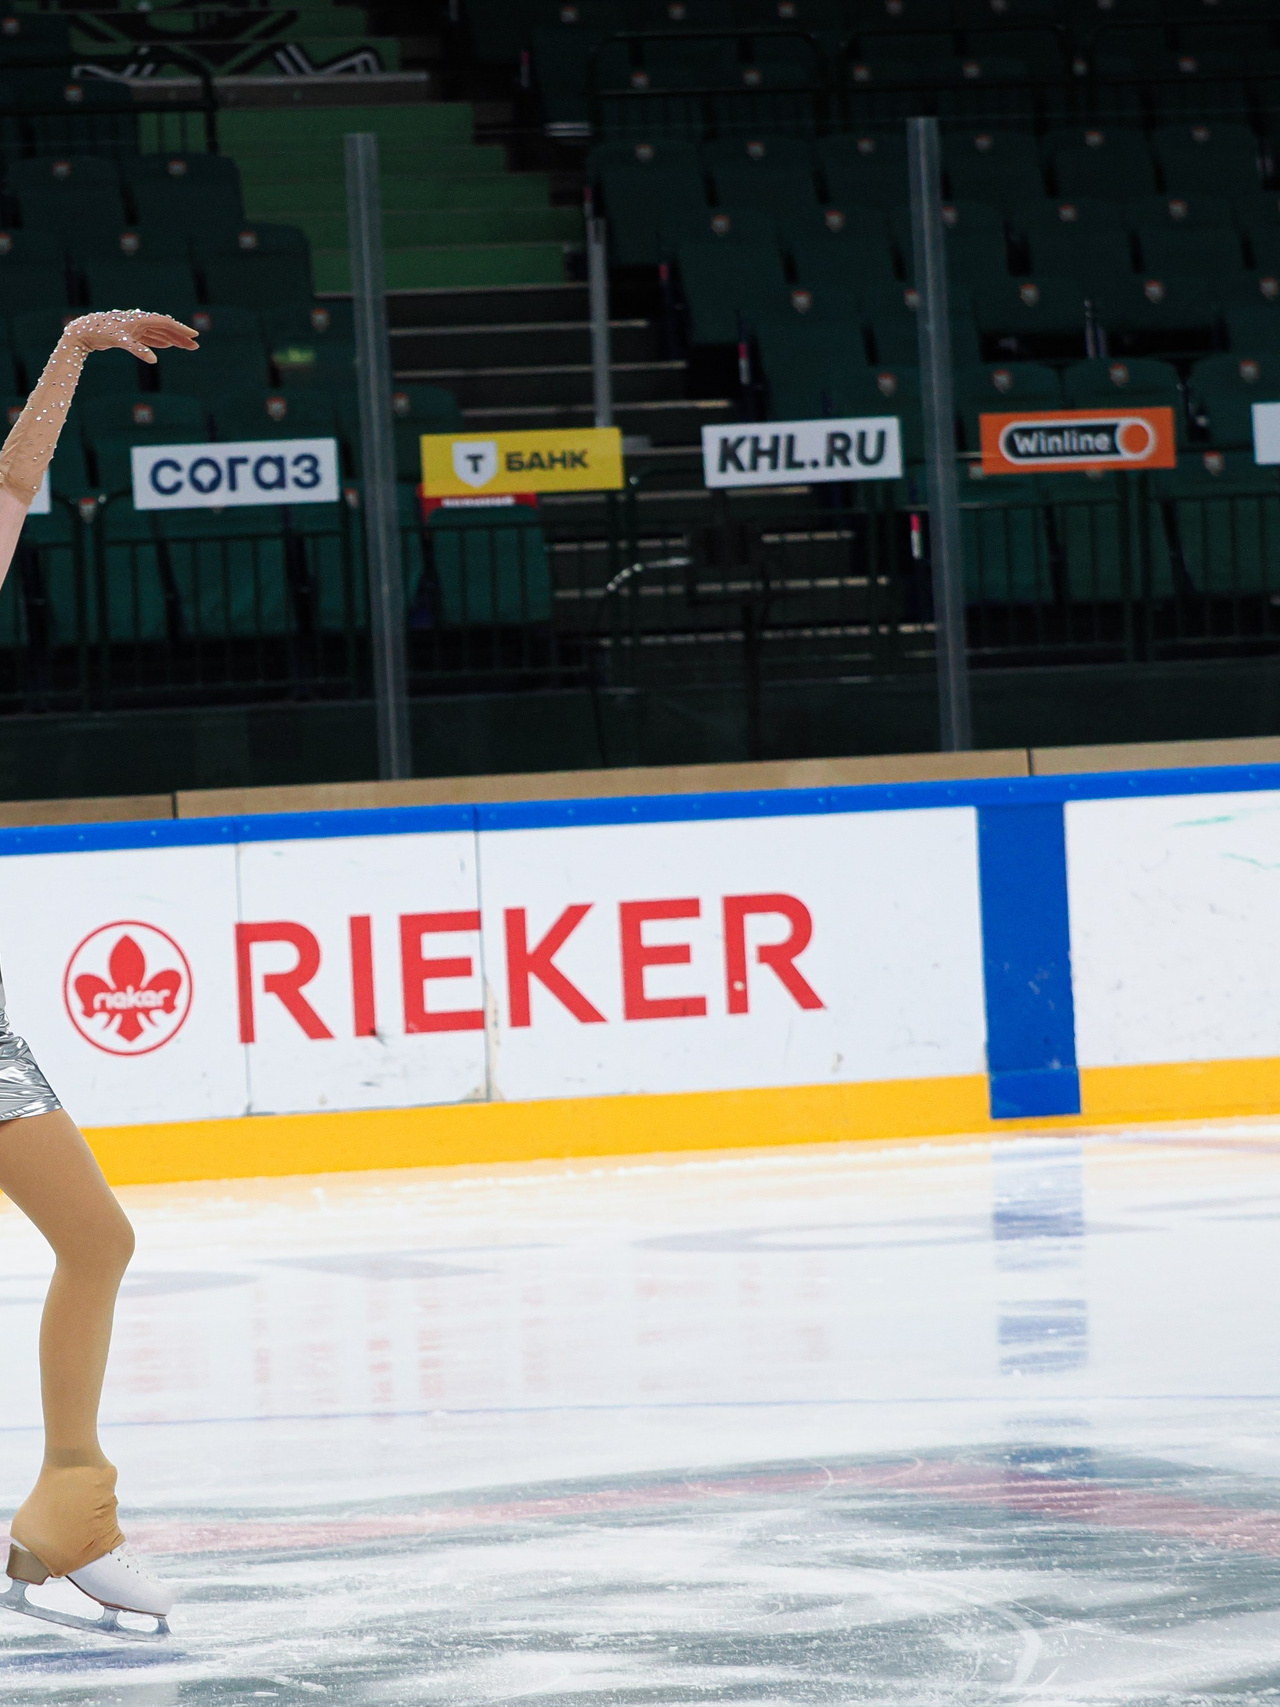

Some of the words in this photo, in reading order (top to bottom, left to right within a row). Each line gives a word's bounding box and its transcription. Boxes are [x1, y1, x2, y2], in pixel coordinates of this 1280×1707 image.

[718, 429, 886, 473] KHL.RU
[1012, 428, 1111, 456] Winline
[505, 449, 588, 472] БАНК
[235, 892, 827, 1044] RIEKER
